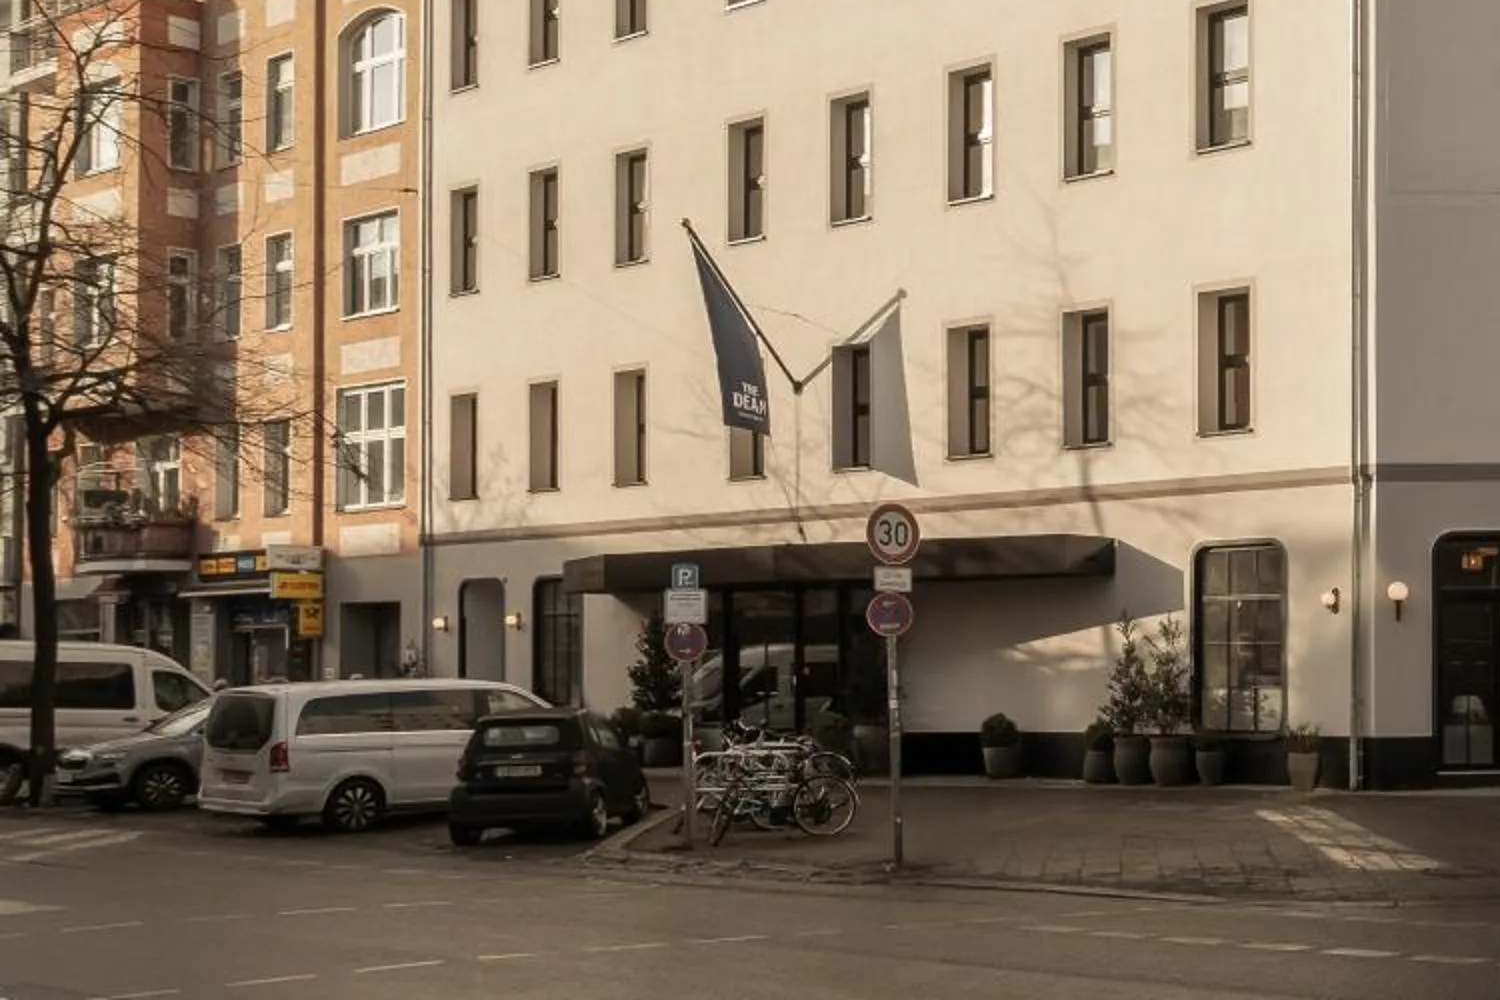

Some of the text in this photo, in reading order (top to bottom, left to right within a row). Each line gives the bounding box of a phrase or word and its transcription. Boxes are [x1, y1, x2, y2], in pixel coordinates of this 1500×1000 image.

[741, 381, 760, 397] THE
[732, 391, 767, 416] DEAN
[879, 520, 908, 545] 30
[678, 568, 692, 586] P
